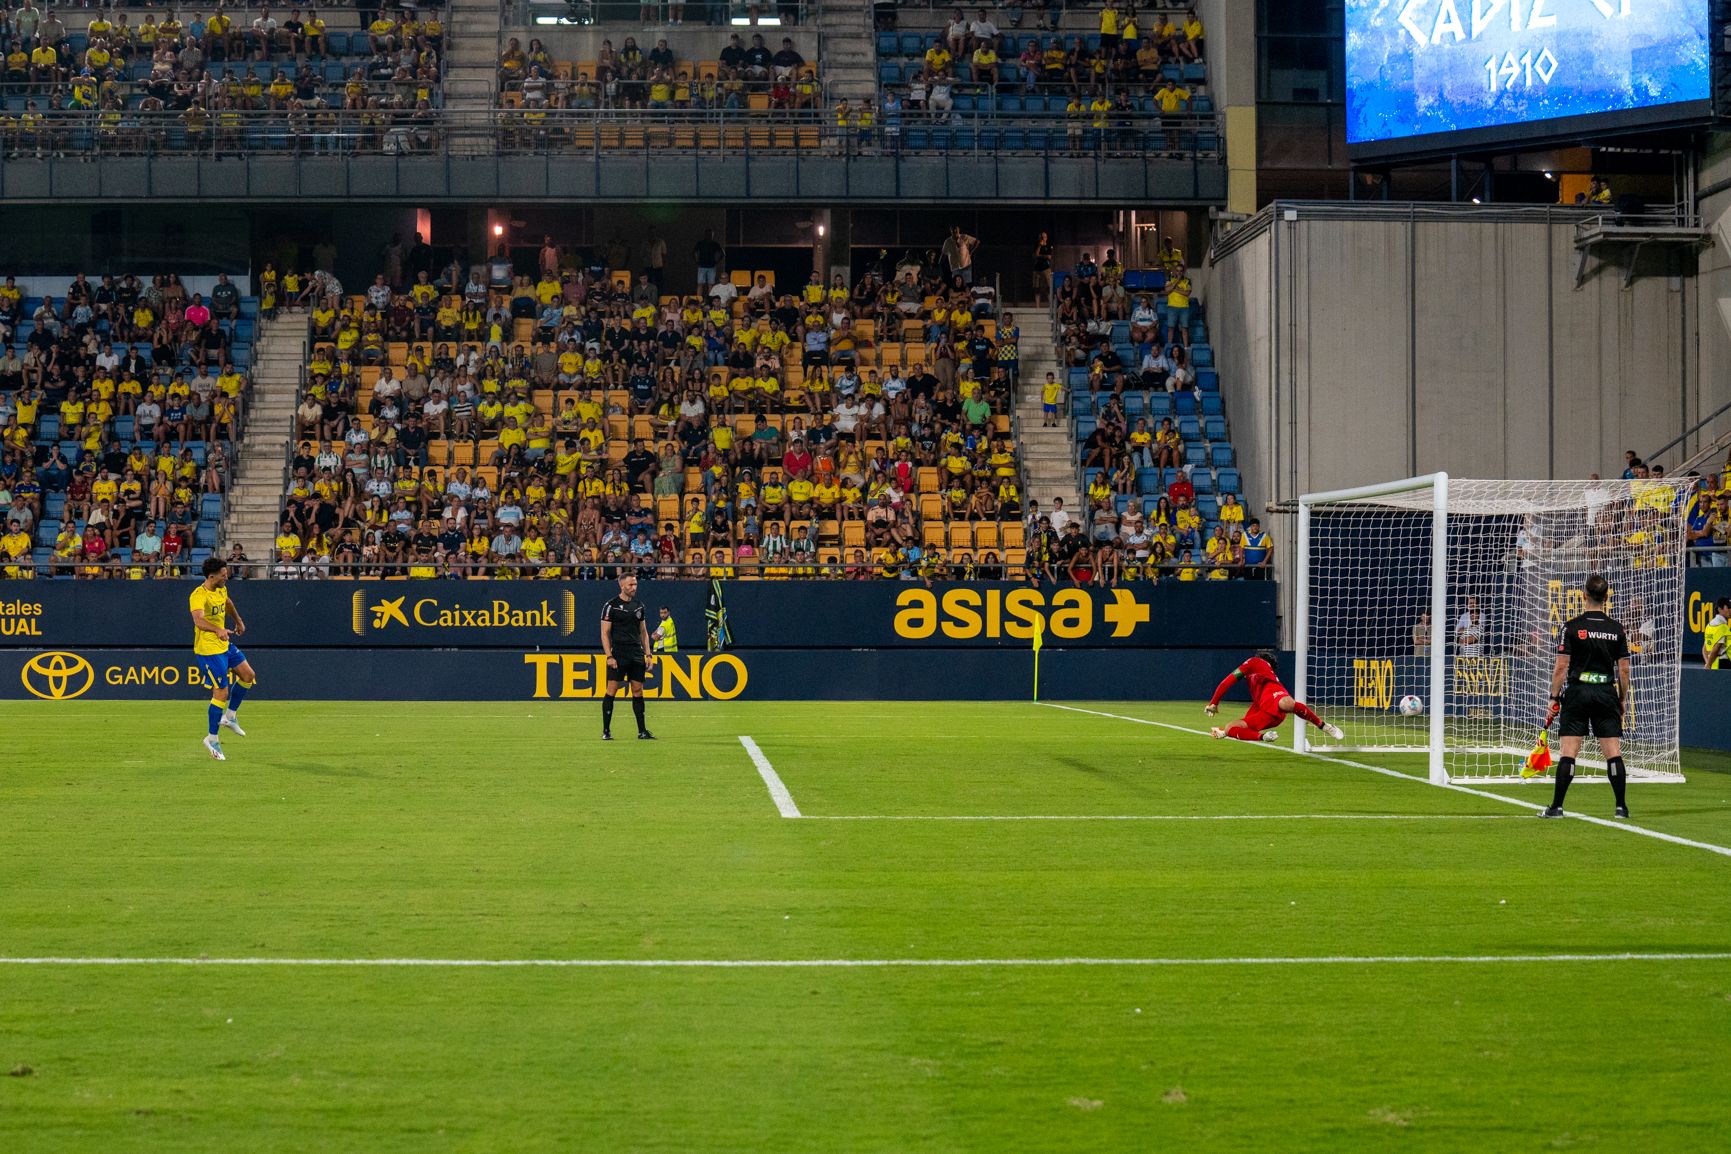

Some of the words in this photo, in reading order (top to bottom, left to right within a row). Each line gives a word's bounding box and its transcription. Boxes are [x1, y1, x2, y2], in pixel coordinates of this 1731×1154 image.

[1484, 47, 1559, 92] 1910
[413, 598, 558, 627] CaixaBank
[893, 588, 1093, 639] asisa
[105, 666, 179, 686] GAMO
[1353, 659, 1394, 710] TELENO
[1579, 673, 1608, 684] BKT
